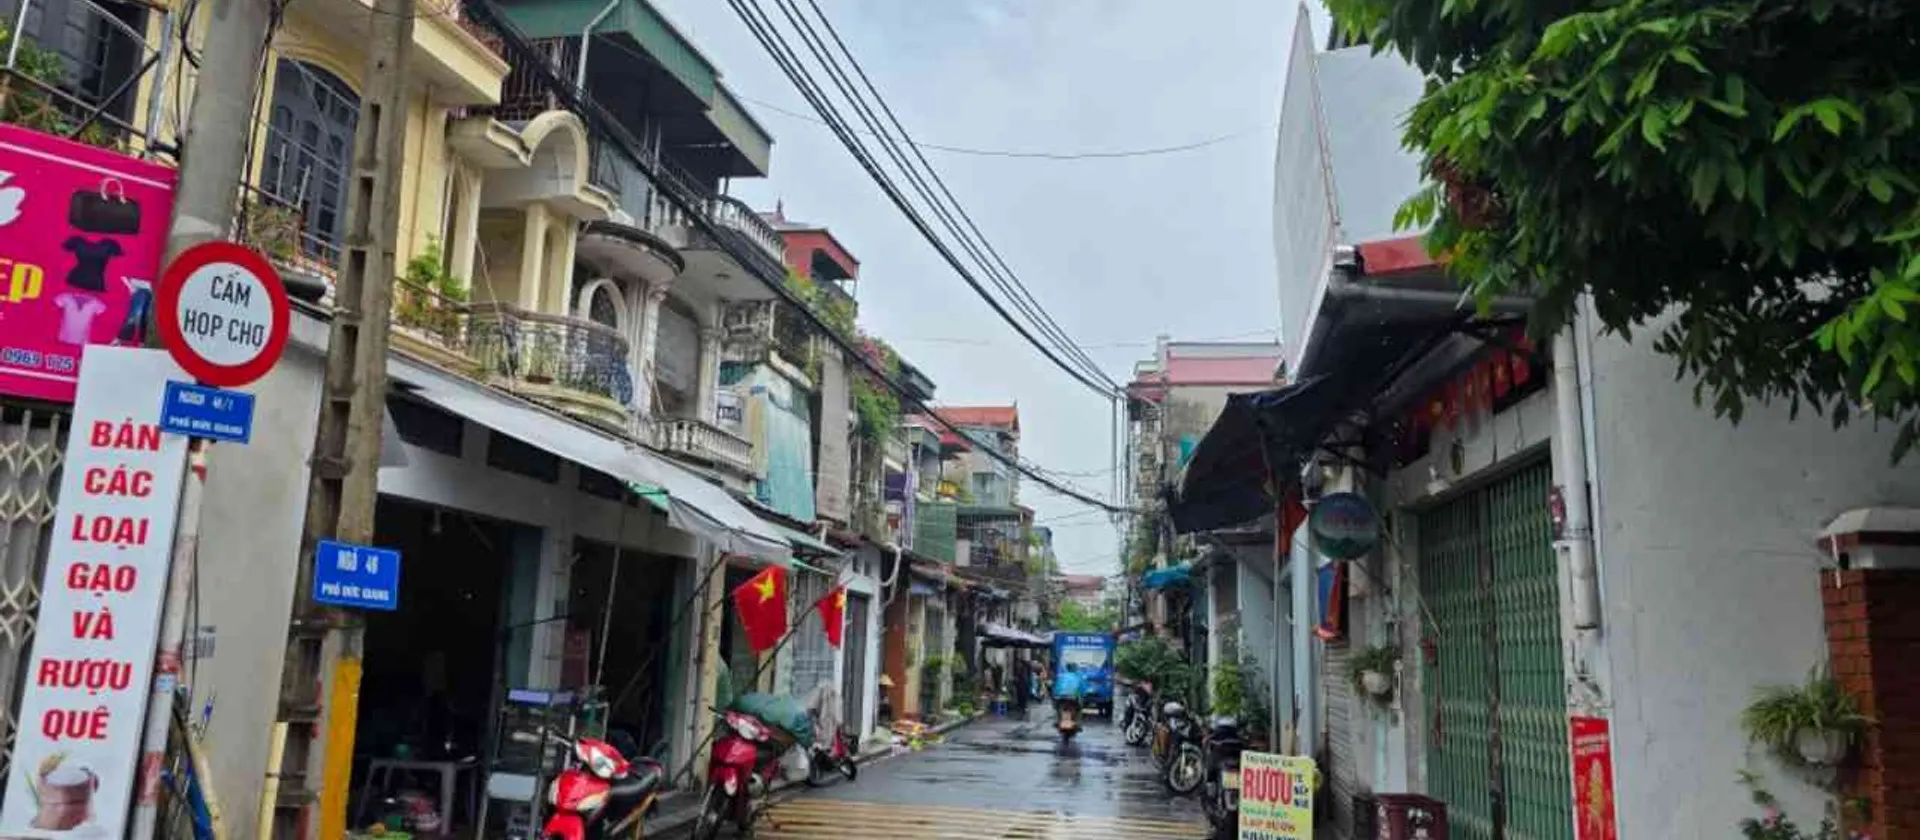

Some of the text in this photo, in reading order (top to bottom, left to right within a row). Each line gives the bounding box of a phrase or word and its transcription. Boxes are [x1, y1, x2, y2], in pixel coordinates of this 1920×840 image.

[211, 271, 251, 308] CẤM
[184, 309, 264, 352] HỌP CHỢ
[90, 416, 161, 452] BÁN
[84, 463, 154, 498] CÁC
[71, 513, 149, 550] LOẠI
[67, 561, 137, 598] GẠO
[73, 606, 114, 640] VÀ
[38, 657, 132, 696] RƯỢU
[42, 704, 110, 742] QUÊ
[1243, 765, 1293, 810] RƯỢU
